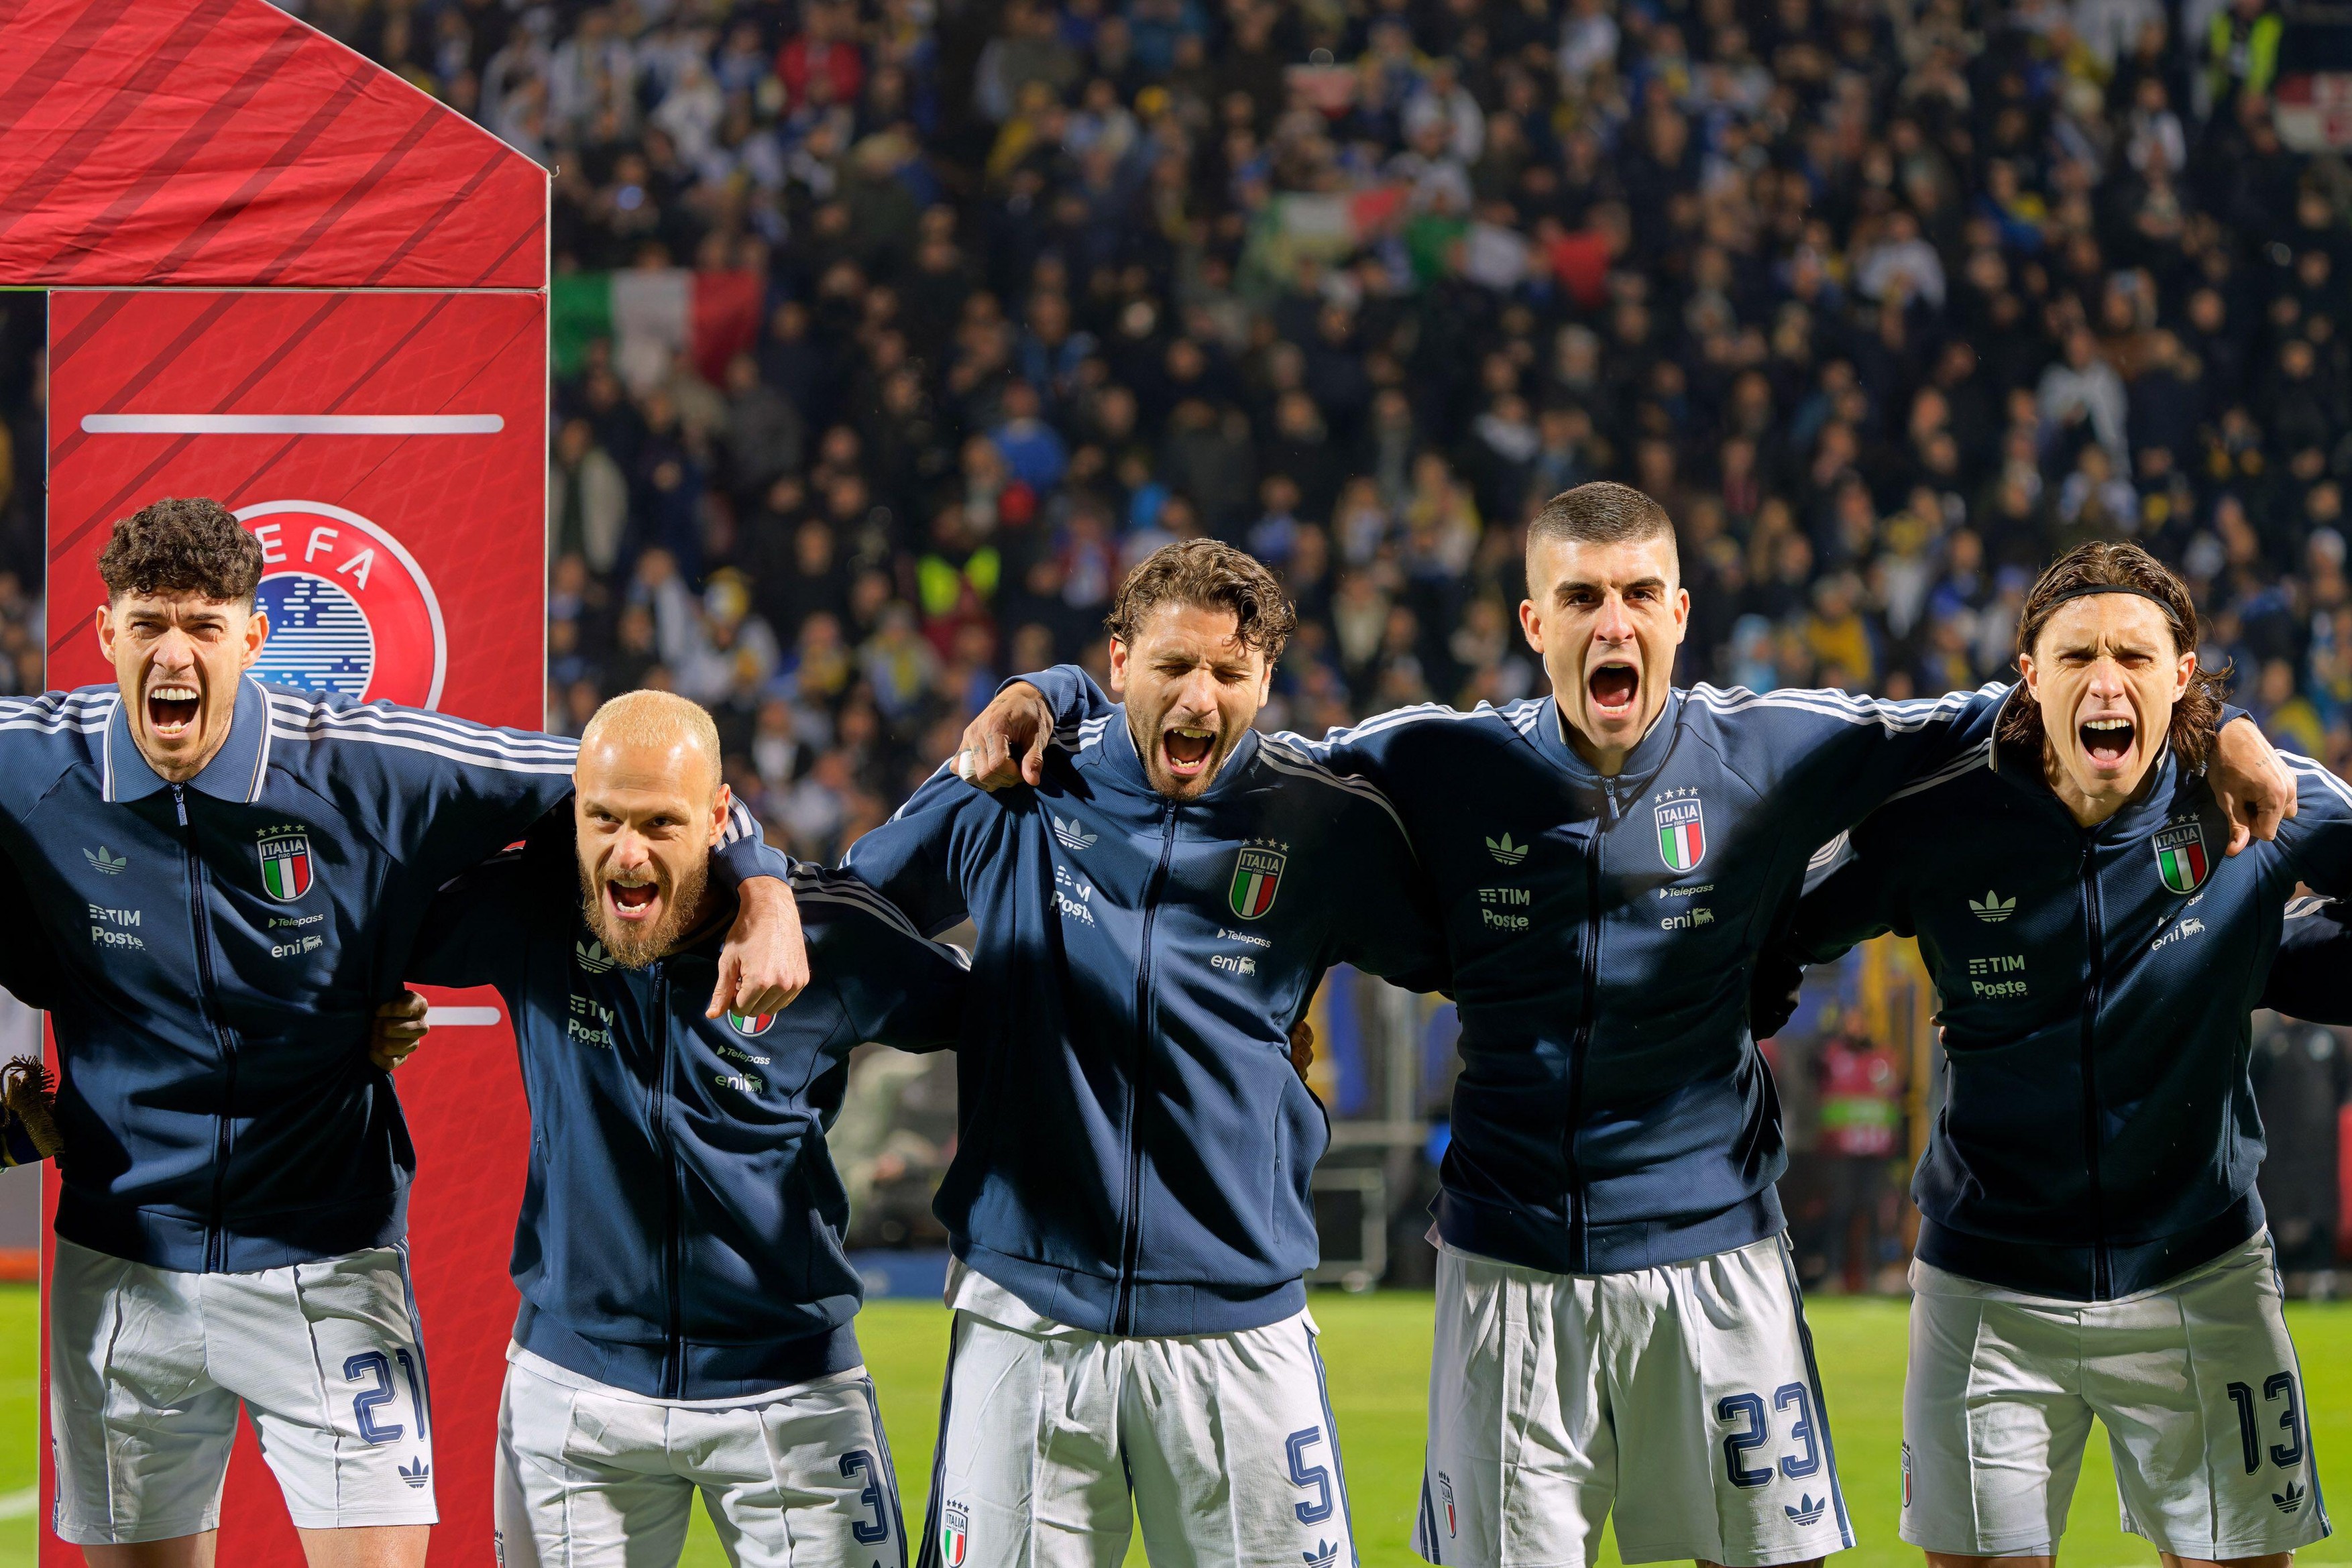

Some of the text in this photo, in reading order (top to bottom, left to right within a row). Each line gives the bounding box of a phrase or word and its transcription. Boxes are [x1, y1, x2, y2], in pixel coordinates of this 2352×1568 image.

[255, 523, 375, 591] EFA
[1659, 805, 1698, 824] ITALIA
[262, 839, 304, 856] ITALIA
[2156, 828, 2198, 848] ITALIA
[1241, 853, 1279, 872] ITALIA
[1498, 889, 1530, 905] TIM
[1669, 885, 1714, 897] Telepass
[105, 909, 140, 926] TIM
[278, 914, 323, 928] Telepass
[1481, 908, 1529, 928] Poste
[1661, 911, 1691, 930] eni
[91, 926, 144, 947] Poste
[1227, 930, 1272, 948] Telepass
[2151, 926, 2180, 951] eni
[272, 940, 300, 958] eni
[1211, 954, 1241, 972] eni
[1989, 954, 2025, 973] TIM
[1972, 981, 2027, 996] Poste
[589, 999, 614, 1027] TM
[727, 1048, 771, 1065] Telepass
[715, 1073, 743, 1090] eni
[343, 1348, 427, 1446] 21
[2227, 1370, 2304, 1475] 13
[1718, 1381, 1822, 1490] 23
[1285, 1425, 1335, 1527] 5
[838, 1449, 890, 1546] 3
[946, 1513, 964, 1530] ITALIA
